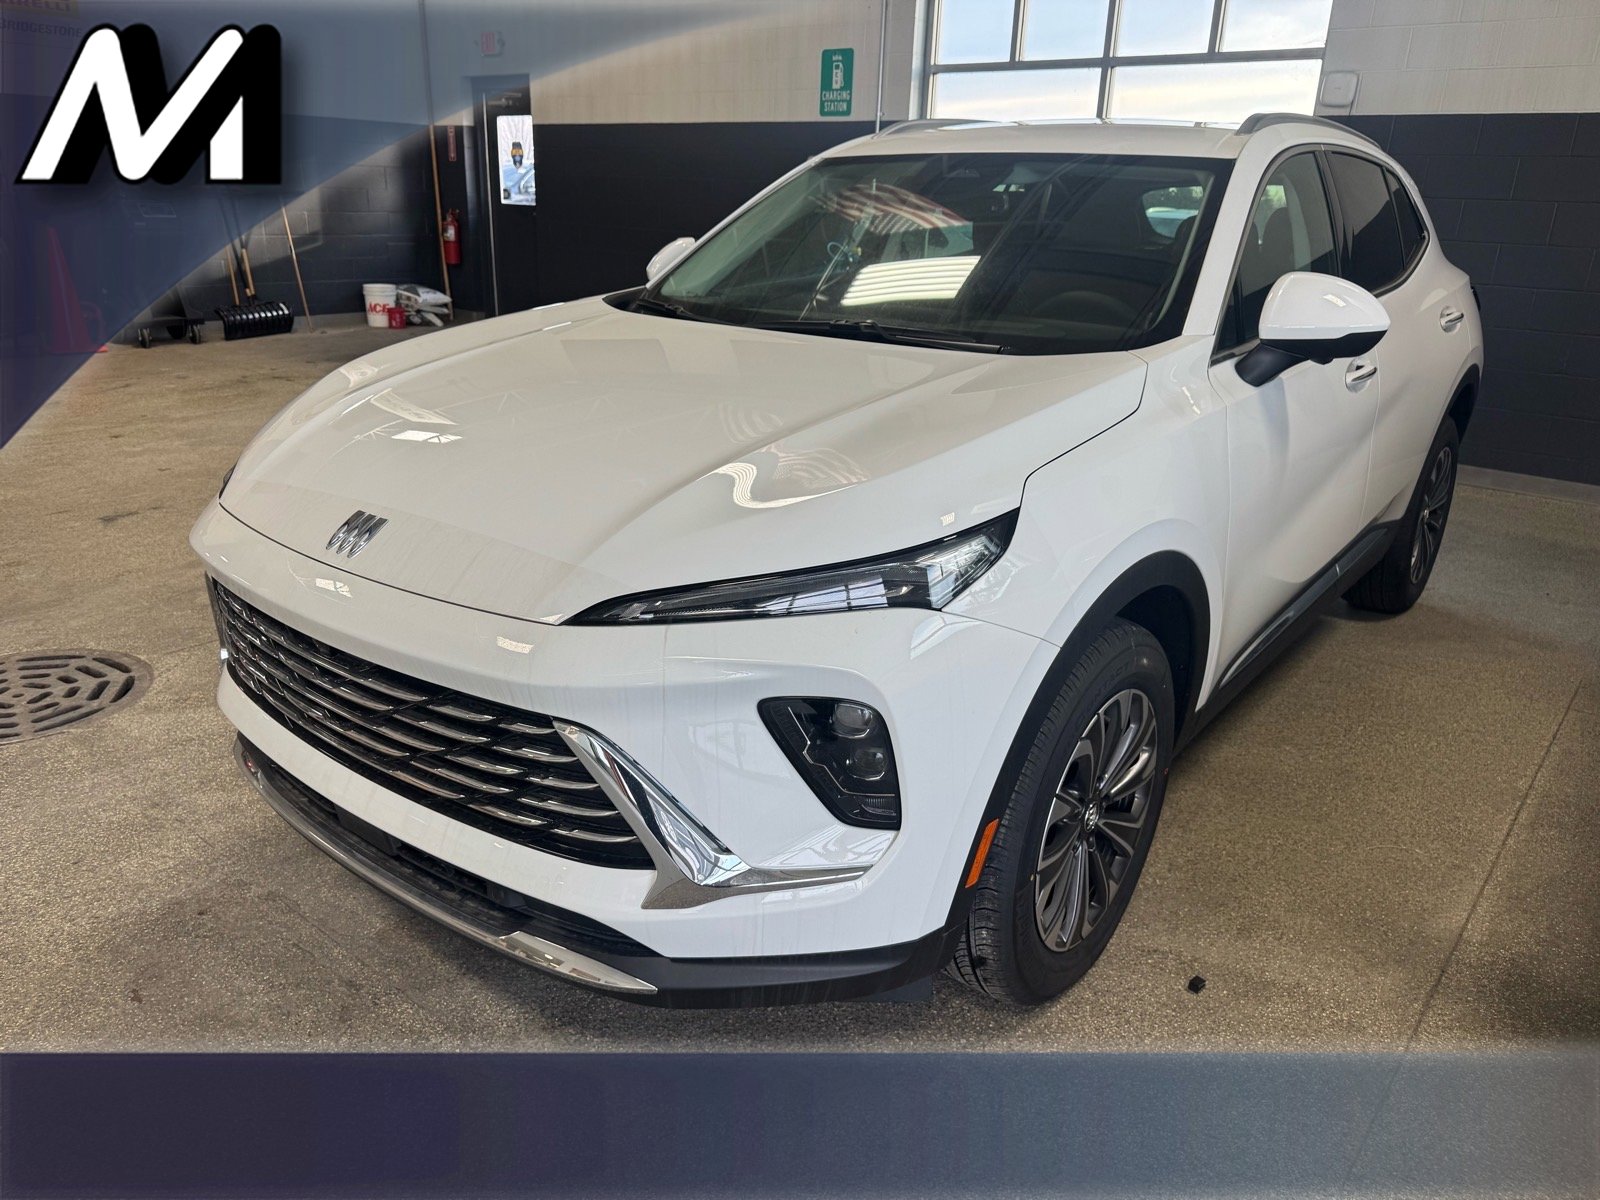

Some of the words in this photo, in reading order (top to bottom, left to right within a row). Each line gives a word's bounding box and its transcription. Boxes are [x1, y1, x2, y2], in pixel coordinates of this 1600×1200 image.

[822, 90, 850, 101] CHARGING
[824, 101, 847, 112] STATION
[368, 303, 390, 314] ACE
